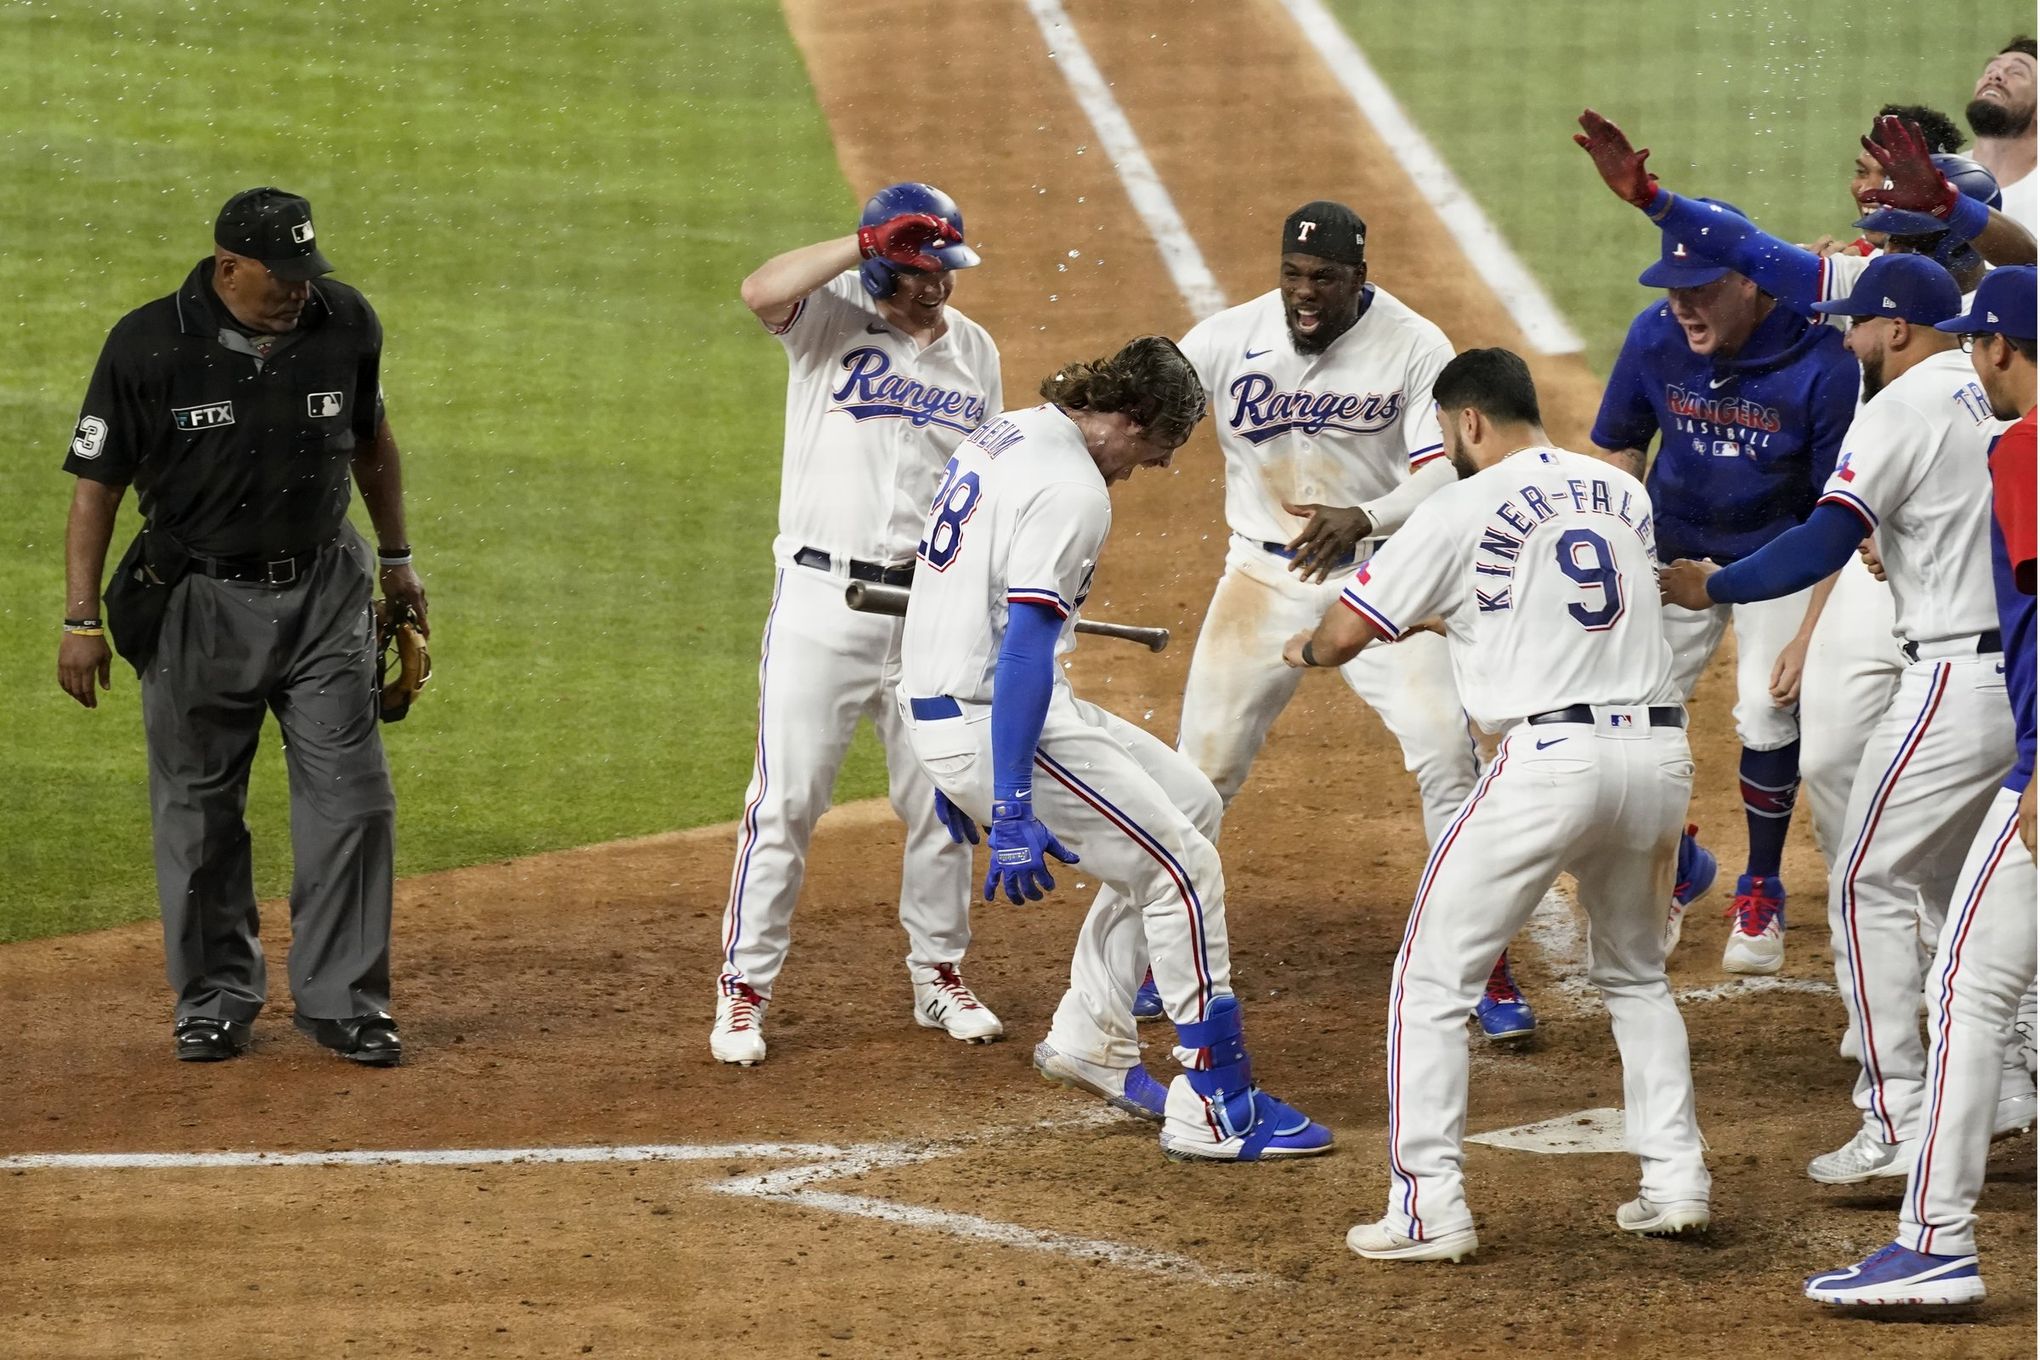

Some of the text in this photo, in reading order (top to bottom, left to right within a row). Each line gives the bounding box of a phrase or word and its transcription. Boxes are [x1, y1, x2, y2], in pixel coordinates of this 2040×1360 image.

[1297, 221, 1316, 242] T
[832, 346, 986, 428] Rangers
[1230, 371, 1406, 437] Rangers
[1666, 383, 1781, 433] RANGERS
[73, 415, 109, 460] 3
[190, 405, 232, 426] FTX
[1676, 418, 1770, 448] BASEBALL
[1475, 479, 1660, 613] KINER-FALE
[1555, 528, 1625, 632] 9
